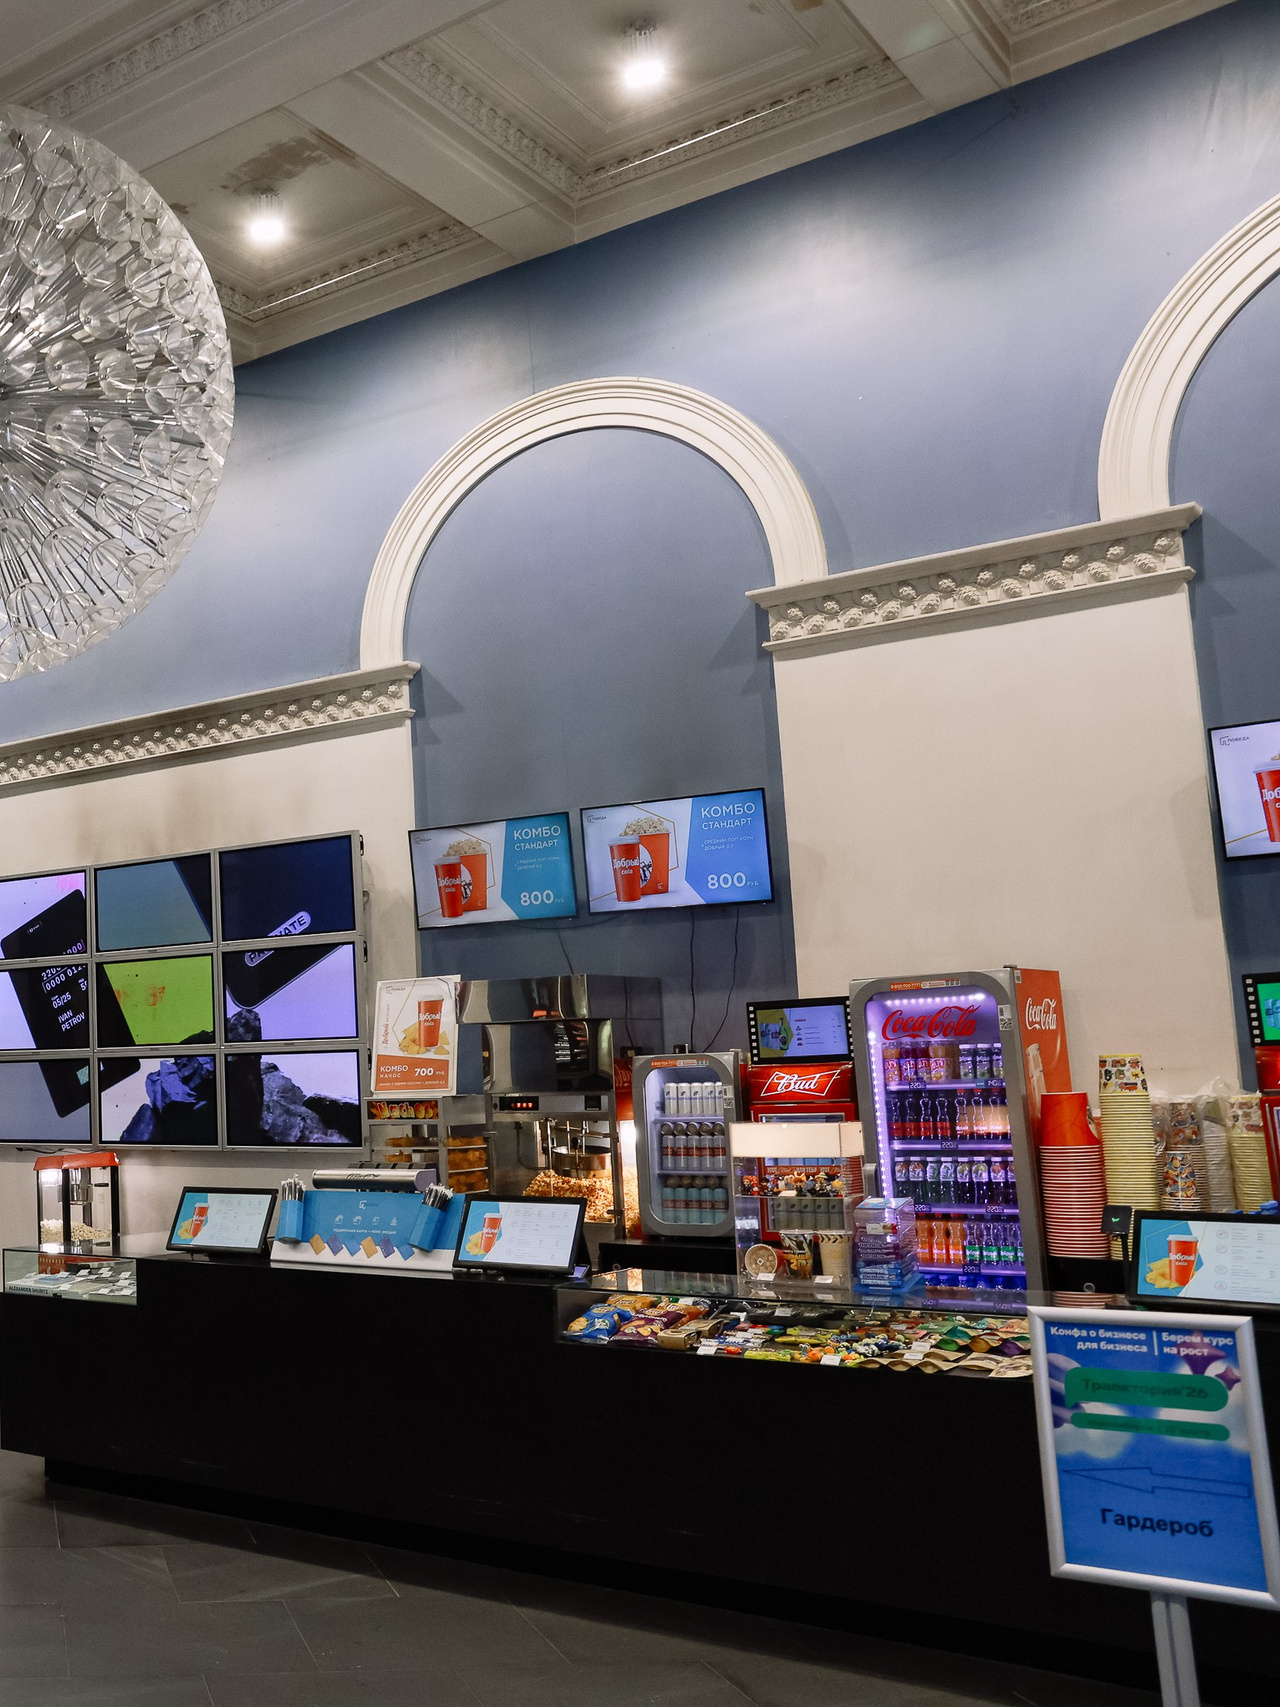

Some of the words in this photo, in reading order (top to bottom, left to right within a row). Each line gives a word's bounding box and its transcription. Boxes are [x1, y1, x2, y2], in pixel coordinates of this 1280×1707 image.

[1262, 788, 1280, 802] Доб
[701, 802, 755, 819] КОМБО
[702, 817, 752, 830] СТАНДАРТ
[514, 825, 561, 840] КОМБО
[515, 839, 558, 851] СТАНДАРТ
[613, 857, 640, 868] Добрый
[707, 872, 747, 890] 800
[520, 890, 554, 907] 800
[52, 992, 72, 1009] 05/25
[58, 1010, 73, 1023] IVAN
[1026, 997, 1057, 1030] Coca-Cola
[61, 1012, 85, 1032] PETROV
[882, 1005, 981, 1040] Coca-Cola
[414, 1068, 434, 1077] 700
[773, 1073, 819, 1092] Bud
[1050, 1327, 1087, 1341] Конфа
[1098, 1328, 1146, 1340] бизнесе
[1077, 1341, 1098, 1351] для
[1100, 1341, 1148, 1353] бизнеса
[1201, 1337, 1233, 1347] курс
[1163, 1346, 1178, 1355] на
[1180, 1347, 1209, 1357] рост
[1100, 1508, 1214, 1537] Гардероб
